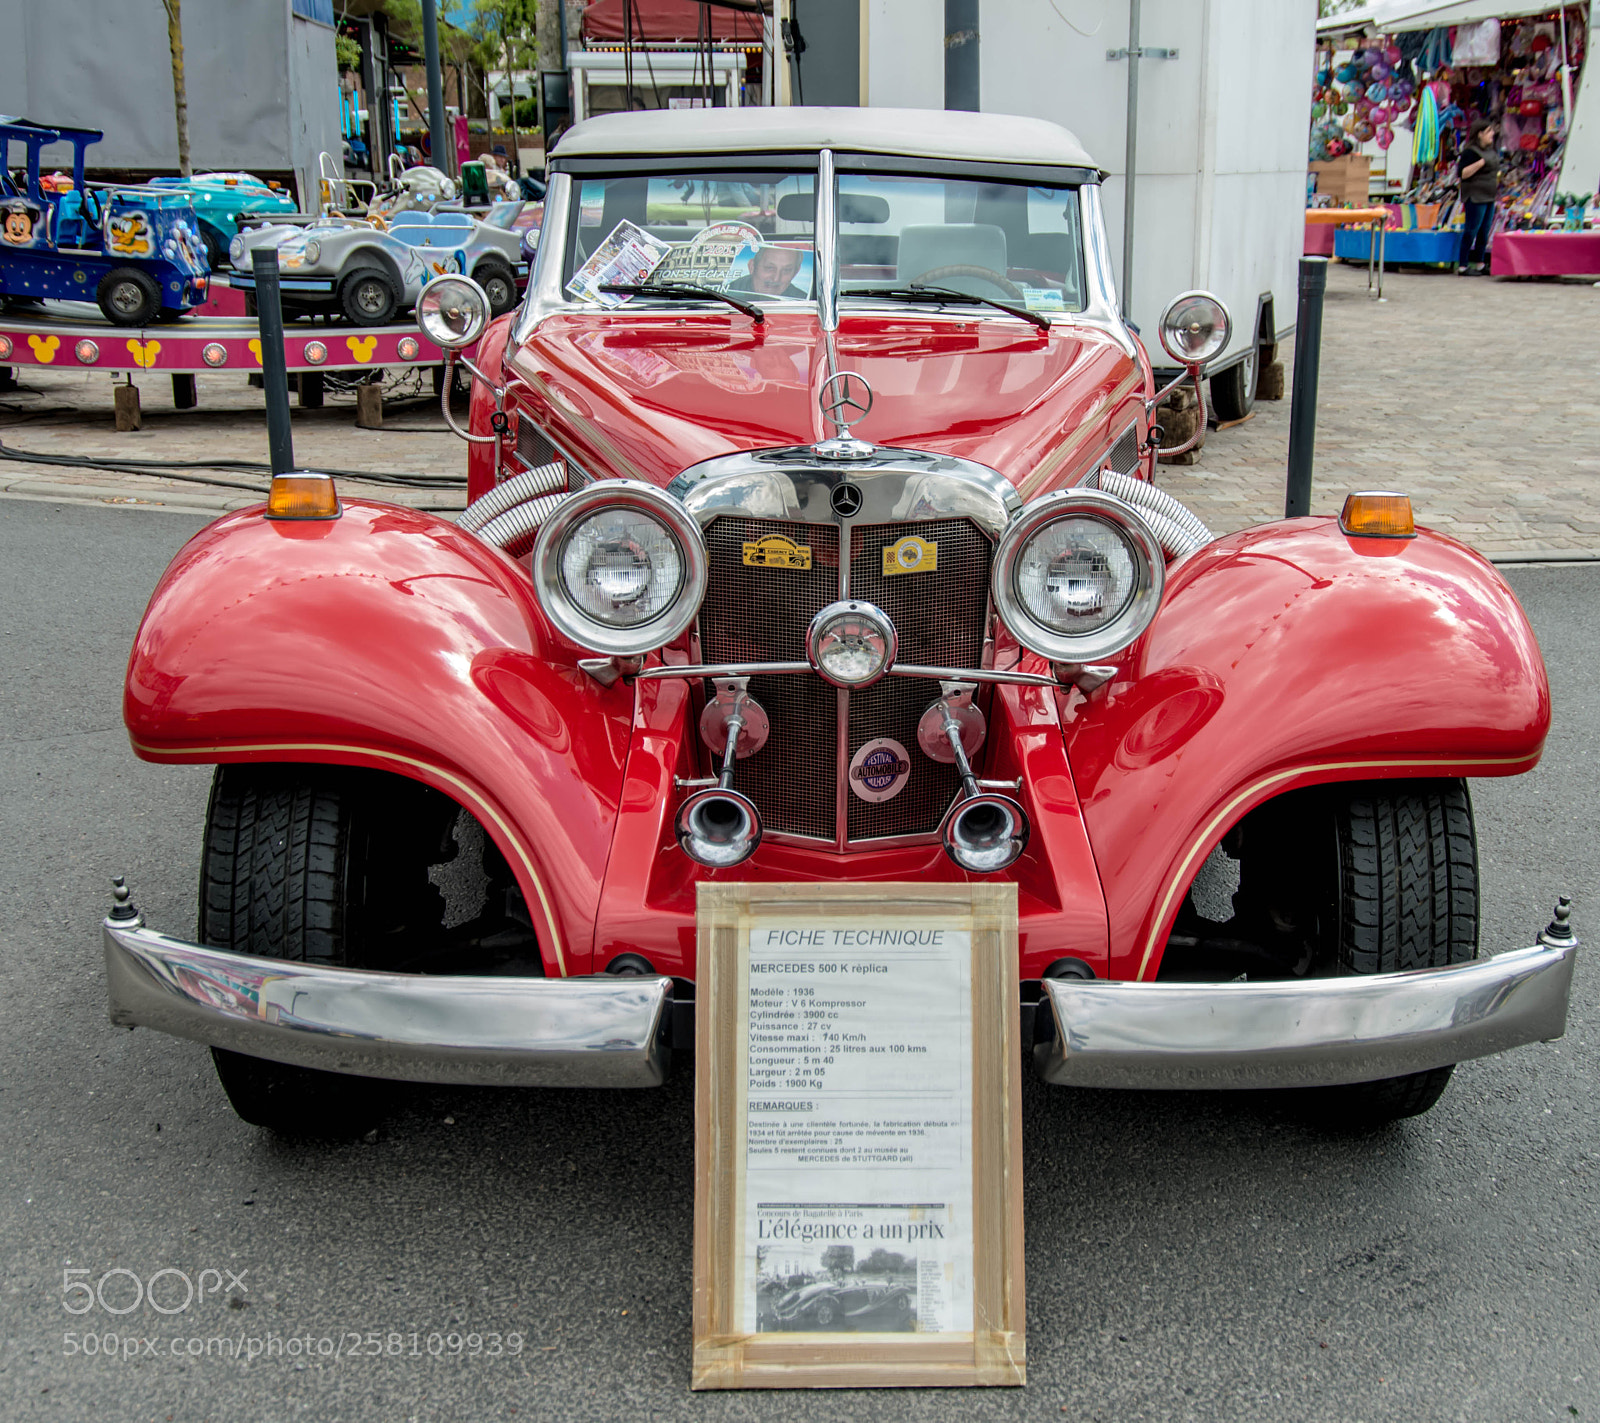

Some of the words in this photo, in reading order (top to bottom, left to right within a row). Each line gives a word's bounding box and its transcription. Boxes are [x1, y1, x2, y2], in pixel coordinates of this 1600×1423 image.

[703, 244, 745, 256] 2017
[682, 269, 740, 278] SPECIALE
[867, 753, 892, 765] FESTIVAL
[858, 762, 902, 777] AUTOMOBILE
[767, 930, 825, 945] FICHE
[833, 929, 944, 946] TECHNIQUE
[751, 963, 815, 973] MERCEDES
[819, 963, 837, 973] 500
[841, 963, 848, 973] K
[793, 988, 814, 996] 1936
[750, 999, 783, 1008] Moteur
[791, 999, 798, 1007] V
[801, 999, 806, 1008] 6
[809, 999, 866, 1009] Kompressor
[750, 1010, 795, 1021] Cylindrée
[804, 1010, 825, 1019] 3900
[750, 1022, 798, 1031] Puissance
[807, 1021, 818, 1030] 27
[750, 1033, 784, 1042] Vitesse
[842, 1033, 866, 1041] Km/h
[749, 1044, 821, 1054] Consommation
[830, 1044, 840, 1053] 25
[843, 1045, 866, 1053] litres
[889, 1044, 905, 1053] 100
[908, 1044, 926, 1053] kms
[749, 1056, 795, 1067] Longueur
[823, 1056, 834, 1064] 40
[749, 1067, 786, 1078] Largeur
[795, 1067, 800, 1076] 2
[814, 1067, 825, 1076] 05
[749, 1079, 776, 1088] Poids
[786, 1079, 806, 1088] 1900
[810, 1079, 822, 1090] Kg
[749, 1101, 813, 1111] REMARQUES
[748, 1120, 780, 1128] Destinée
[749, 1129, 765, 1137] 1934
[748, 1138, 777, 1146] Nombre
[858, 1146, 861, 1154] 2
[757, 1209, 791, 1217] Concours
[803, 1209, 836, 1218] Bagatelle
[845, 1209, 863, 1217] Paris
[759, 1218, 857, 1242] L'élégance
[863, 1225, 873, 1239] a
[880, 1225, 902, 1239] un
[908, 1220, 944, 1243] prix
